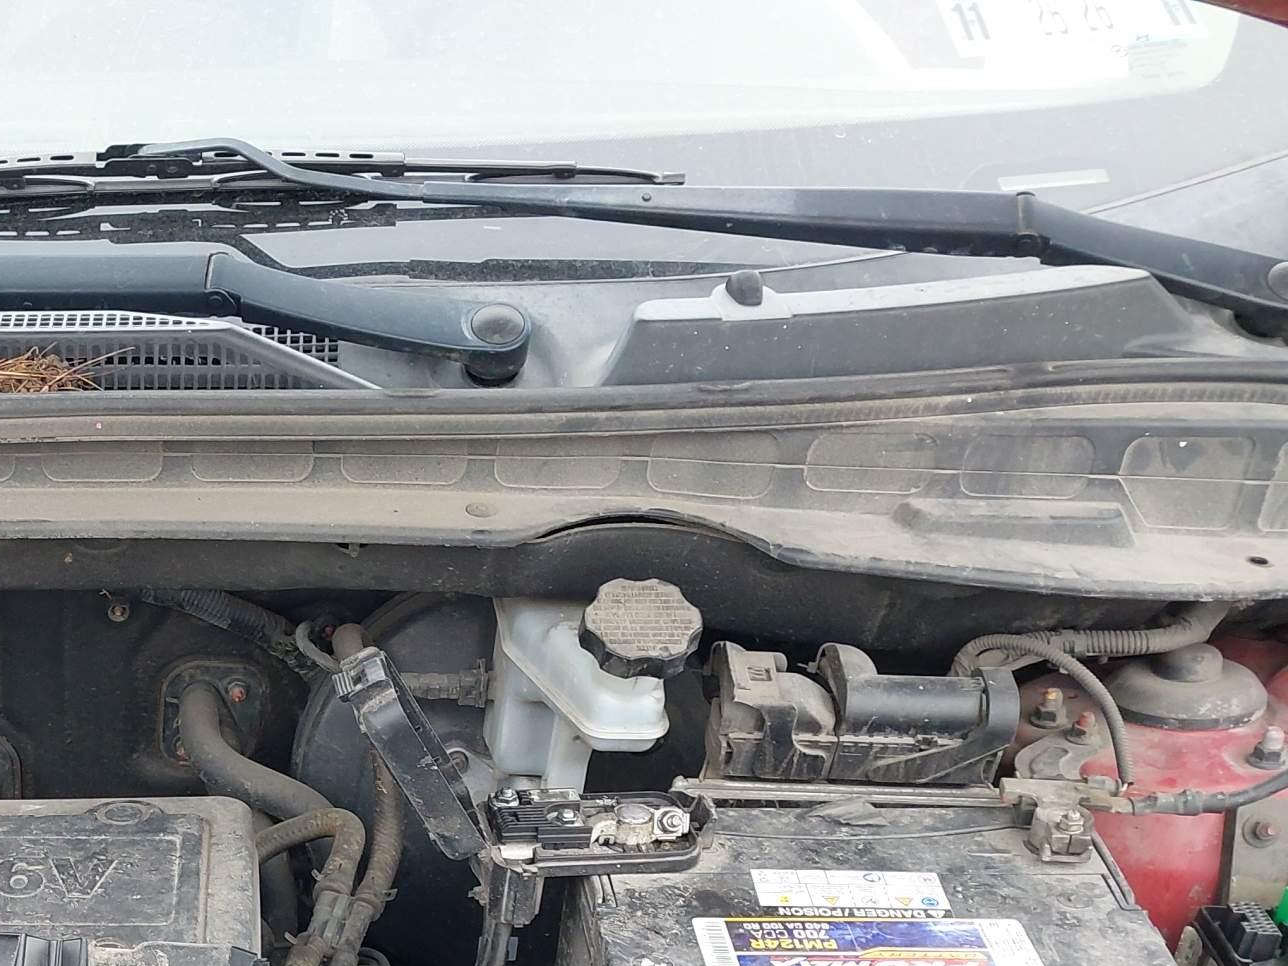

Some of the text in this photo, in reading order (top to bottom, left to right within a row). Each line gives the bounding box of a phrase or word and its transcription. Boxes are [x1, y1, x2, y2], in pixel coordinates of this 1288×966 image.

[777, 905, 841, 918] POISON
[855, 906, 928, 919] DANGER
[750, 929, 831, 939] 700 CCA
[749, 938, 839, 950] PM124R
